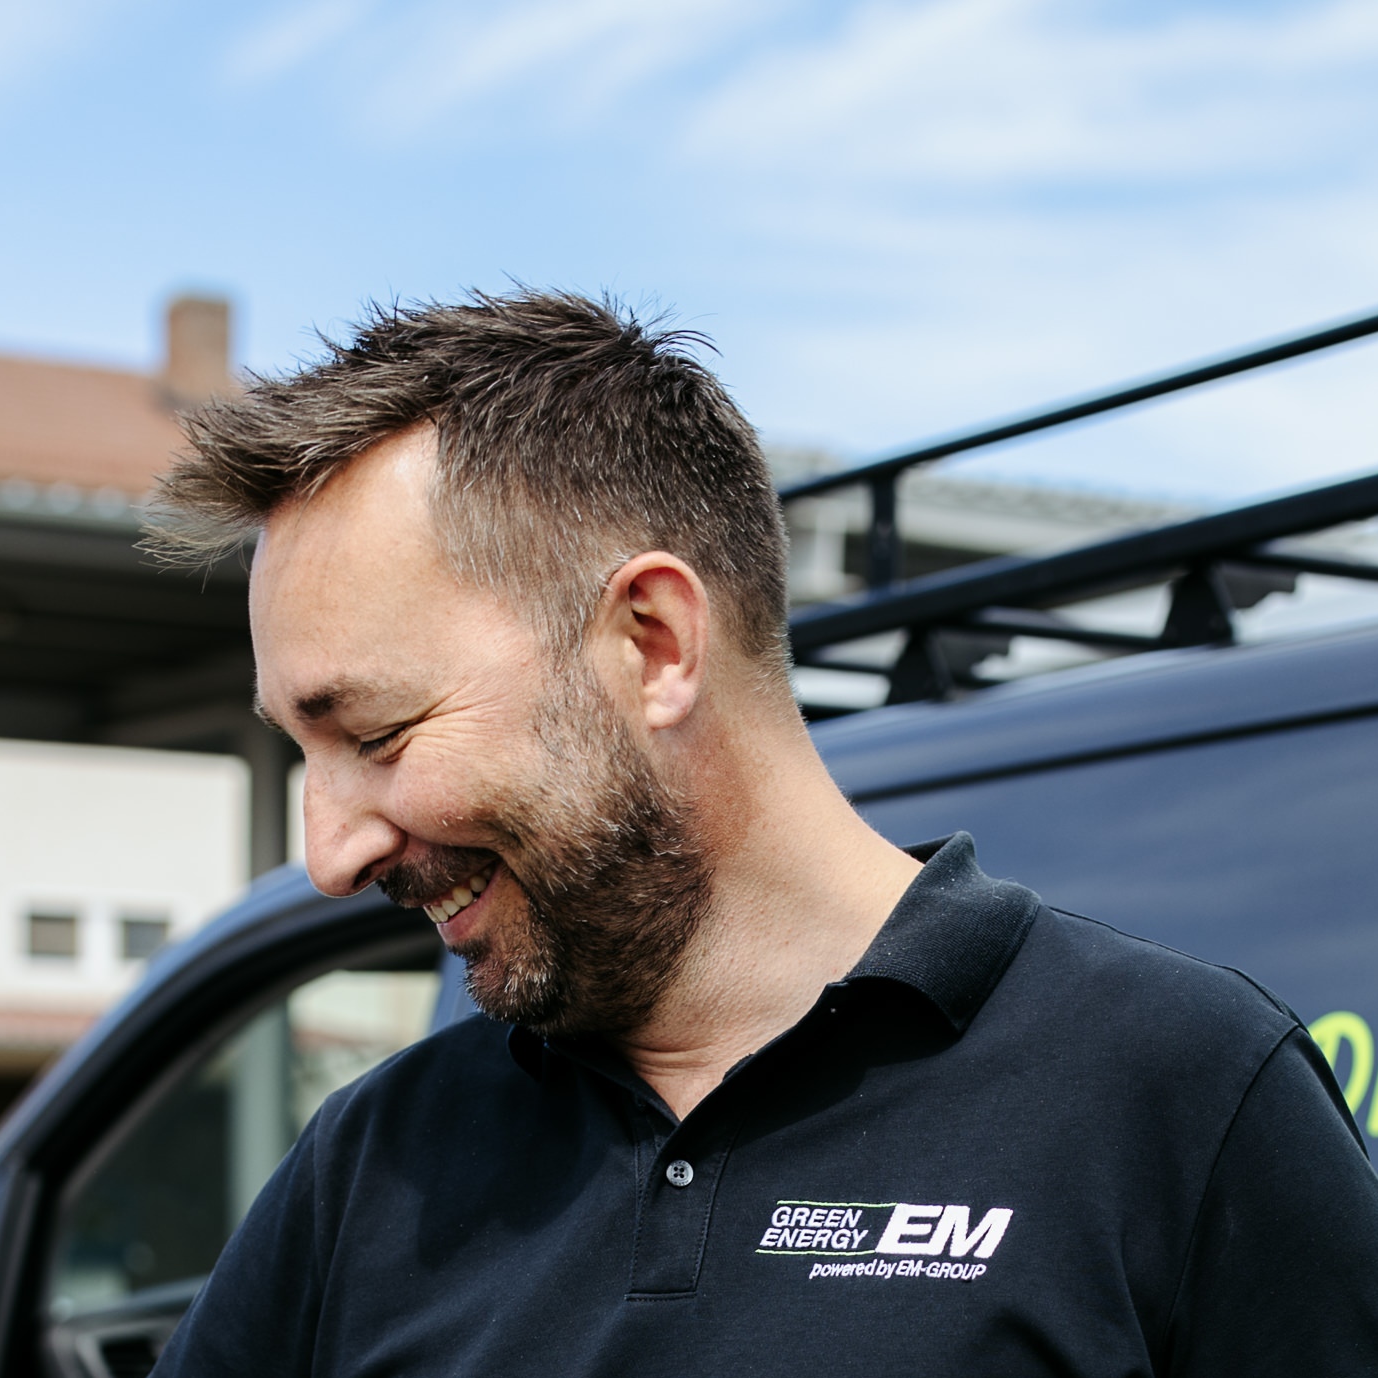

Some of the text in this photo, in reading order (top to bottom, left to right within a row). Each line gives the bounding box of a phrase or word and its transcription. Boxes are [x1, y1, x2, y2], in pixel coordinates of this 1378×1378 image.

[771, 1206, 863, 1229] GREEN
[759, 1227, 870, 1250] ENERGY
[874, 1202, 1015, 1259] EM
[808, 1257, 988, 1281] powered by EM-GROUP
